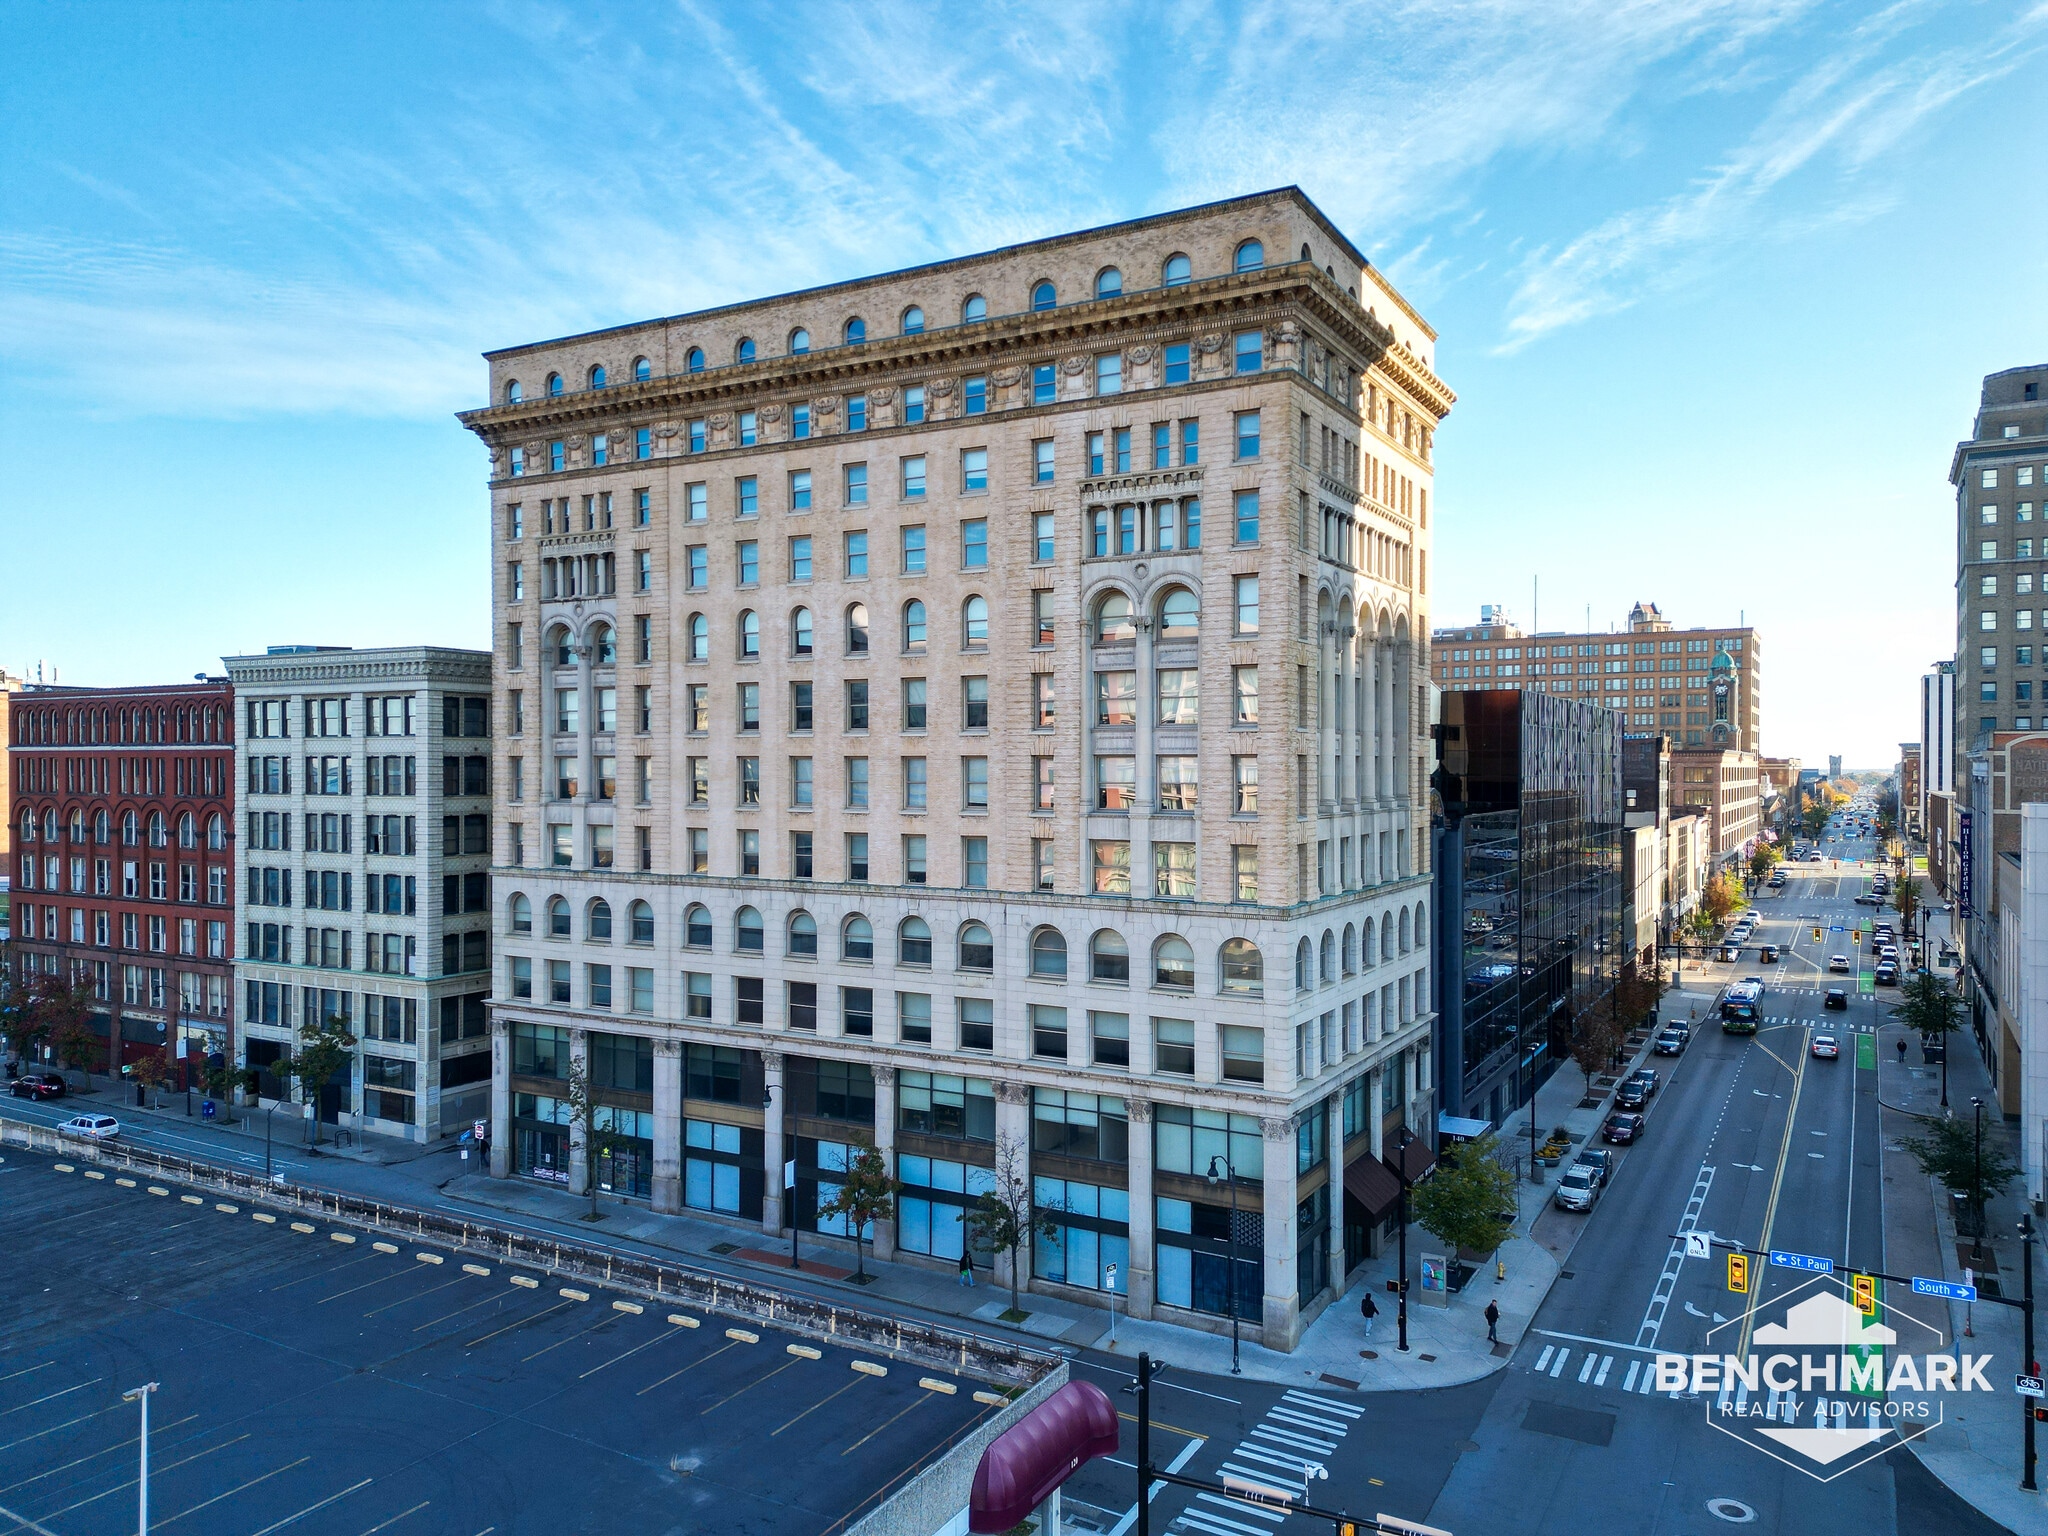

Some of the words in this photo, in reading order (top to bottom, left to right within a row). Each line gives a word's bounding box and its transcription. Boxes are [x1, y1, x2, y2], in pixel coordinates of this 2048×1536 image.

[1790, 1256, 1804, 1267] St.
[1807, 1258, 1828, 1270] Paul
[1918, 1281, 1950, 1296] South
